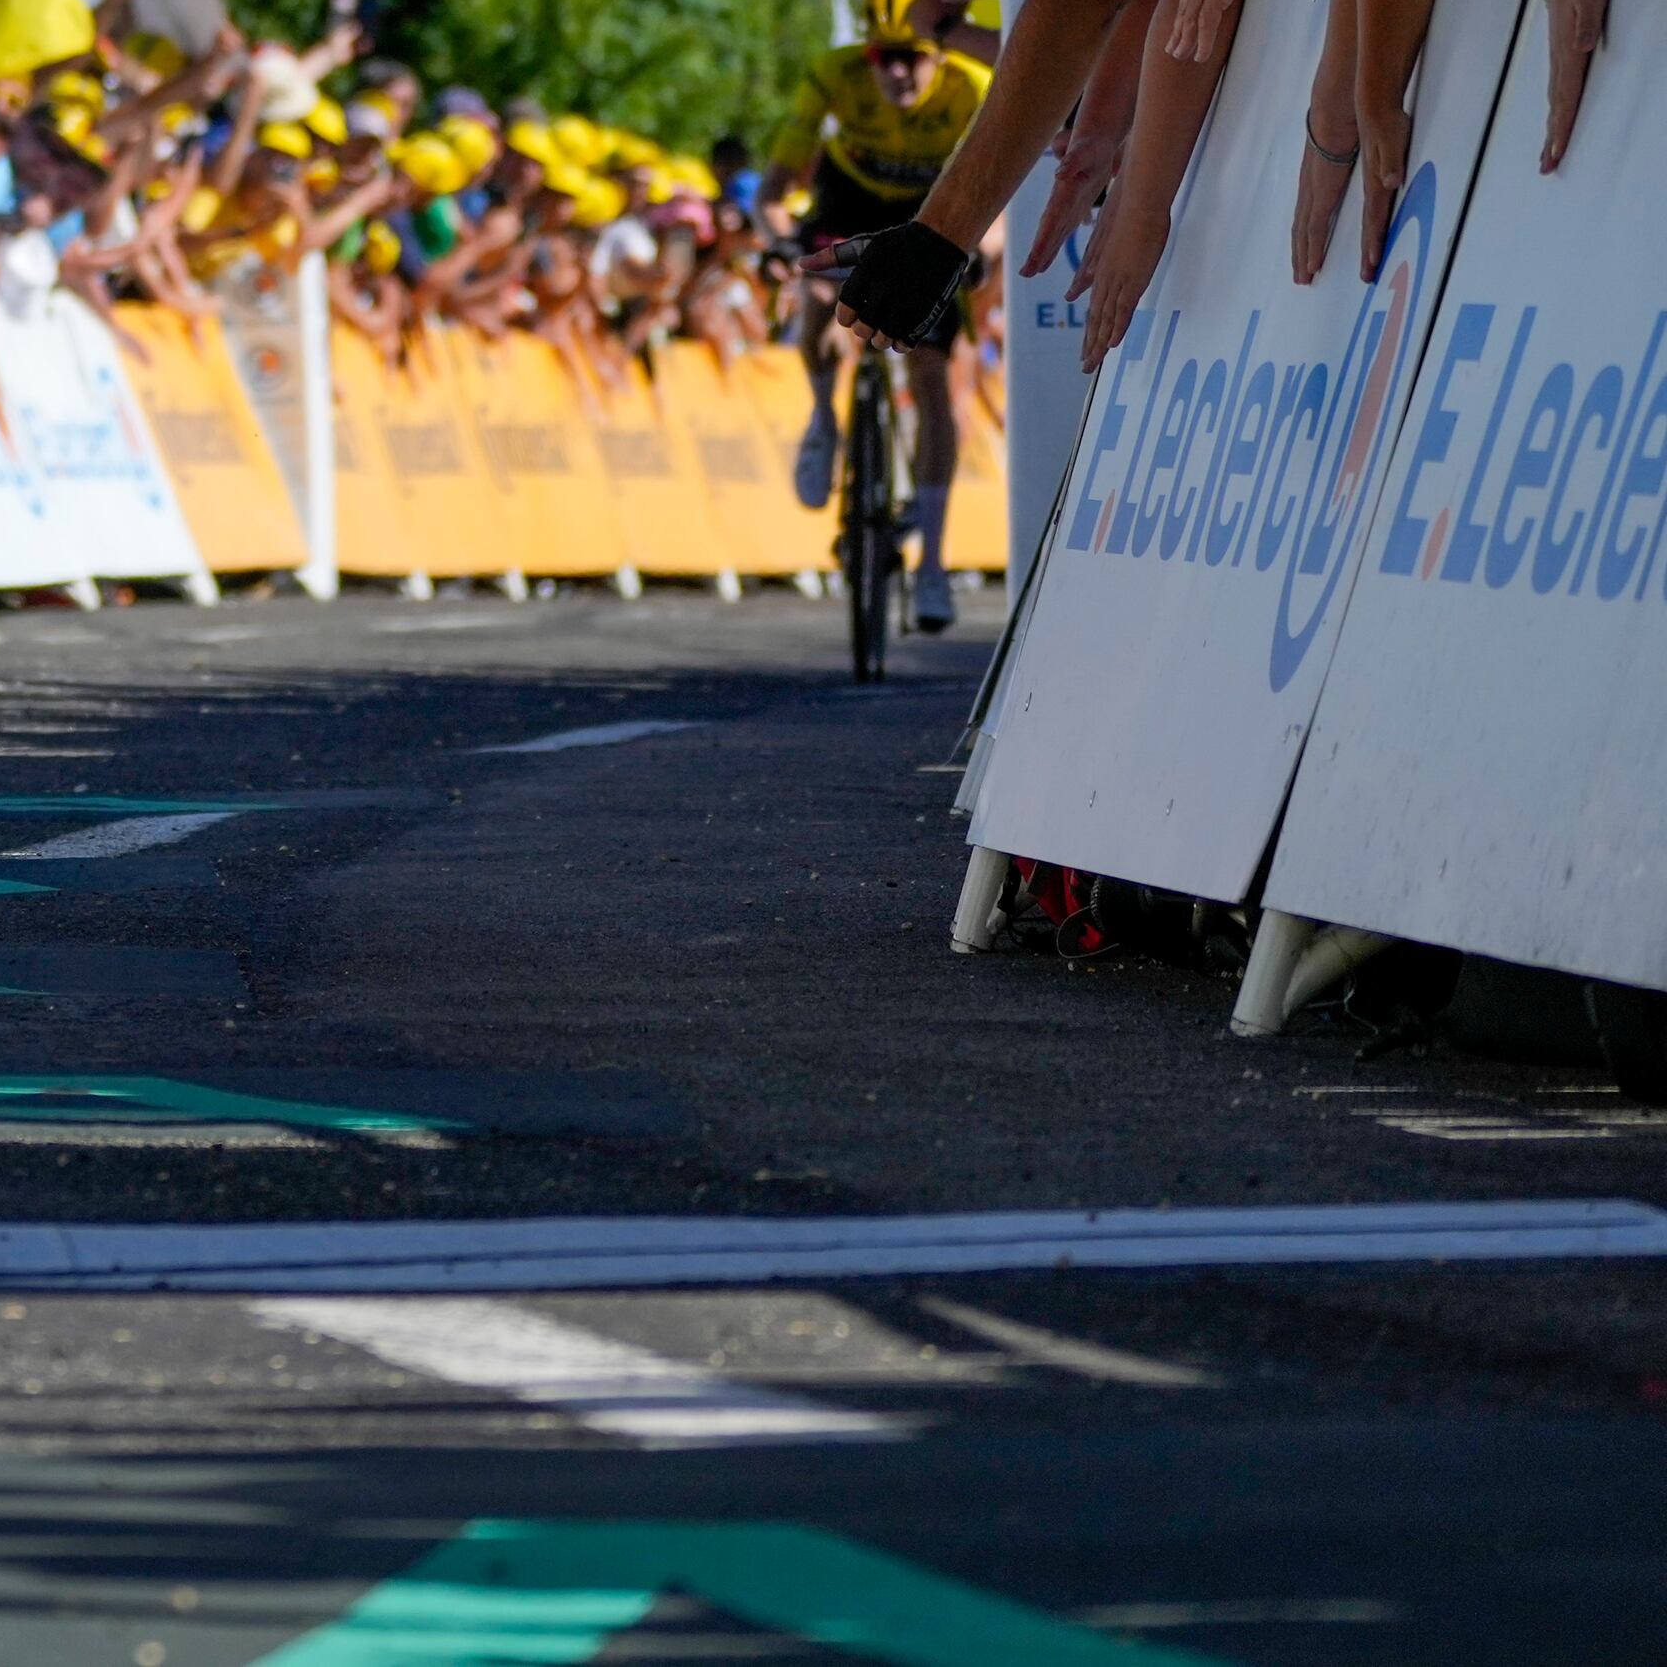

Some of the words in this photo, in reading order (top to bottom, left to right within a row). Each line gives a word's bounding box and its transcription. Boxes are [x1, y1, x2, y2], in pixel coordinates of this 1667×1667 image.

[1036, 302, 1084, 329] E.L
[1065, 308, 1331, 573] E.Leclerc
[1377, 302, 1667, 604] E.Lecle
